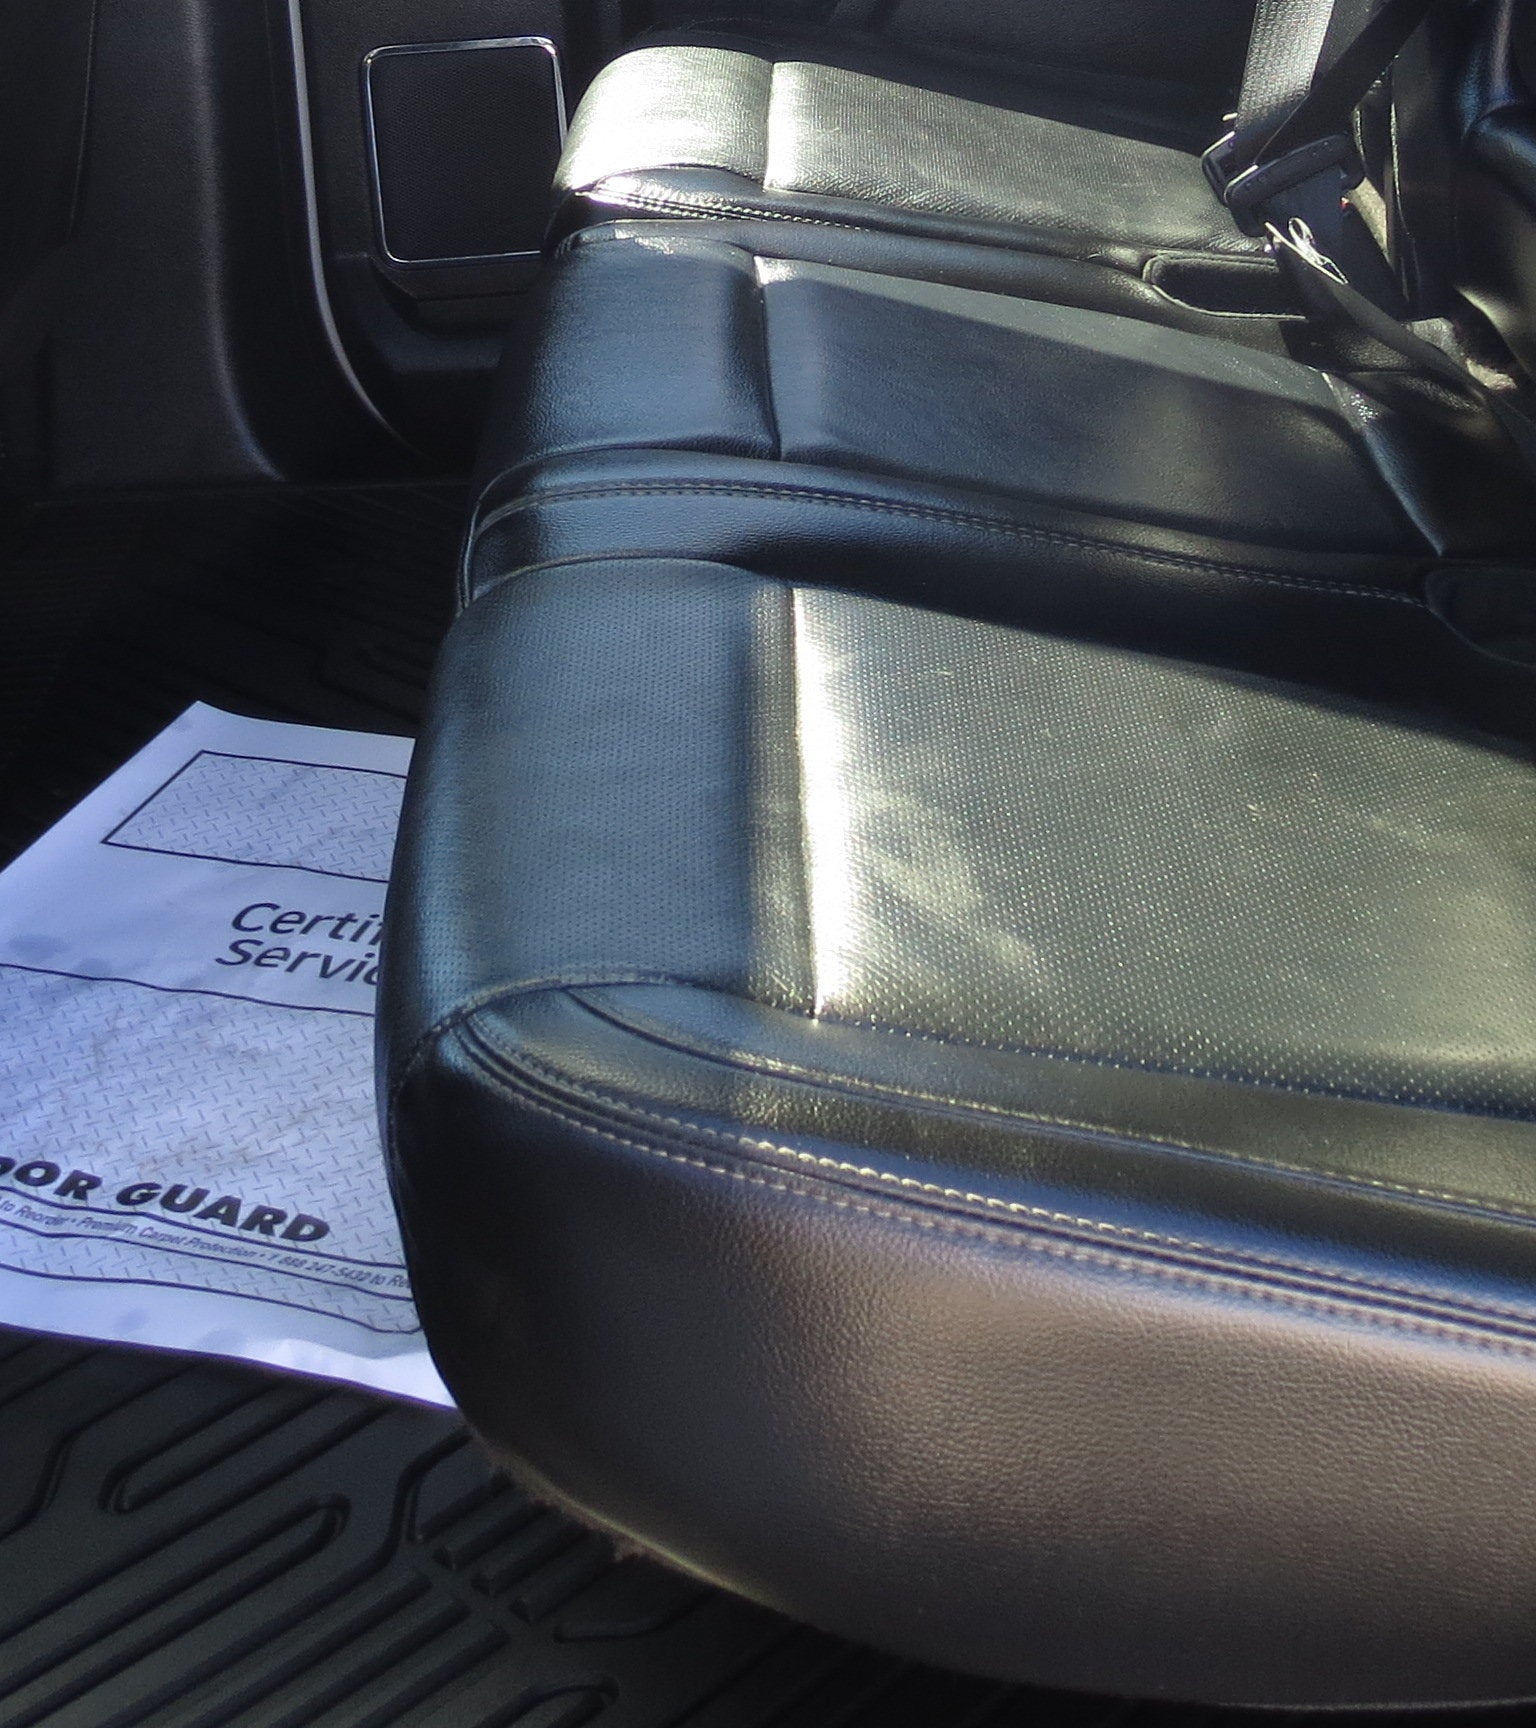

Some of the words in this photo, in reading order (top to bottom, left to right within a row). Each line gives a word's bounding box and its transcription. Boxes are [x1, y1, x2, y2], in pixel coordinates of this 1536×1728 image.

[16, 1204, 70, 1227] Reorder
[76, 1216, 139, 1235] Premium
[138, 1226, 187, 1246] Carpet
[184, 1236, 258, 1258] Protection
[278, 1256, 309, 1269] 888
[369, 1275, 387, 1287] to
[387, 1274, 411, 1289] Re
[115, 1182, 330, 1242] GUARD
